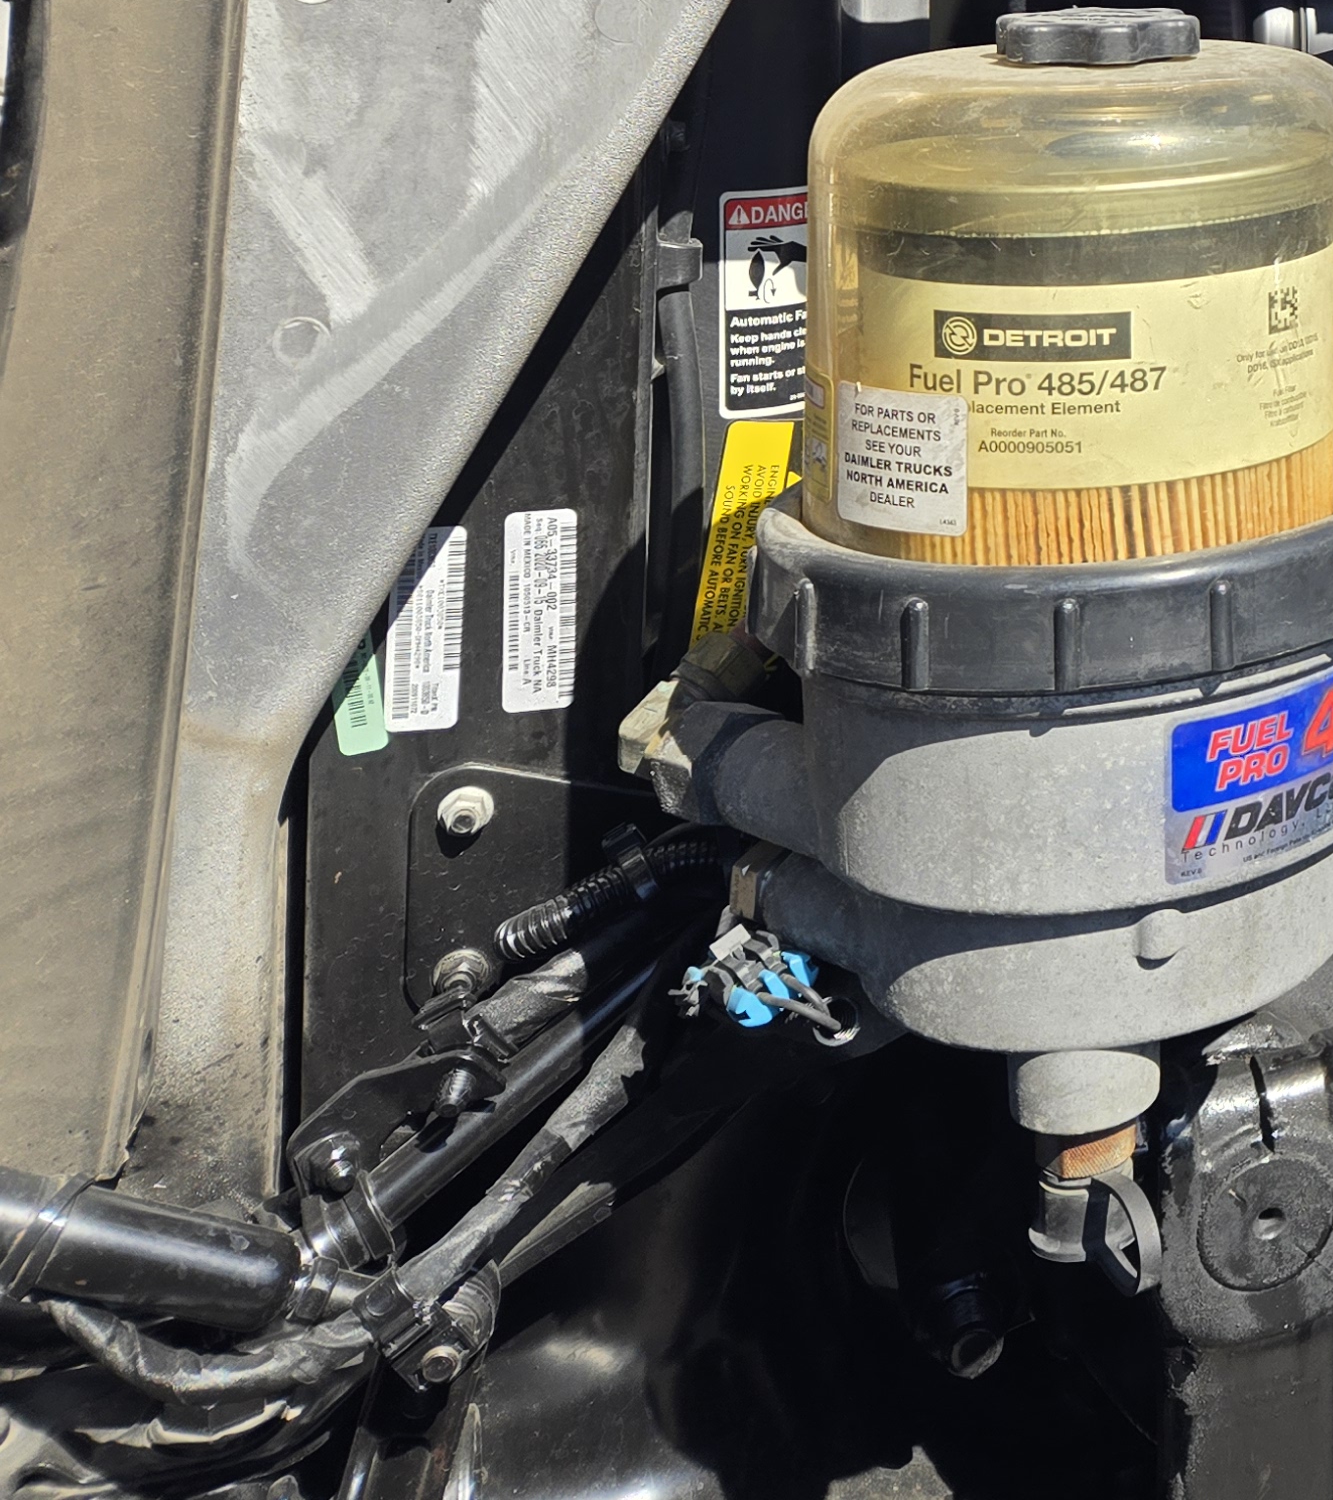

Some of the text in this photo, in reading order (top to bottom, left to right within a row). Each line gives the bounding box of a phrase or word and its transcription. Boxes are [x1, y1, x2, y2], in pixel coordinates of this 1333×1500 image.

[751, 202, 808, 224] DANG
[730, 310, 807, 328] Automatic Fa
[730, 330, 792, 345] Keep hands
[730, 344, 759, 355] when
[761, 342, 796, 354] engine
[983, 328, 1117, 347] DETROIT
[730, 357, 775, 368] running.
[730, 373, 750, 383] Fan
[752, 370, 783, 382] starts
[785, 369, 796, 378] or
[909, 363, 961, 394] Fuel
[1037, 366, 1167, 397] 485/487
[730, 381, 776, 397] by itself.
[855, 403, 936, 424] FOR PARTS OR
[969, 400, 1121, 416] lacement Element
[851, 419, 941, 442] REPLACEMENTS
[991, 428, 1066, 438] Reorder Part No.
[865, 439, 922, 458] SEE YOUR
[978, 440, 1083, 454] A0000905051
[844, 452, 953, 477] DAIMLER TRUCKS
[752, 465, 767, 499] AVOID
[846, 470, 949, 494] NORTH AMERICA
[721, 484, 736, 524] SOUND
[869, 491, 915, 509] DEALER
[746, 502, 761, 541] INJURY,
[524, 538, 530, 546] IN
[710, 527, 727, 566] BEFORE
[714, 465, 753, 619] WORKING ON FAN OR BELTS.
[698, 570, 719, 632] AUTOMATIC
[727, 571, 745, 629] IGNITION
[533, 609, 542, 646] Daimler
[533, 650, 542, 677] Truck
[546, 644, 557, 688] MH4298
[533, 680, 542, 694] NA
[1207, 711, 1294, 763] FUEL
[1215, 743, 1290, 792] PRO
